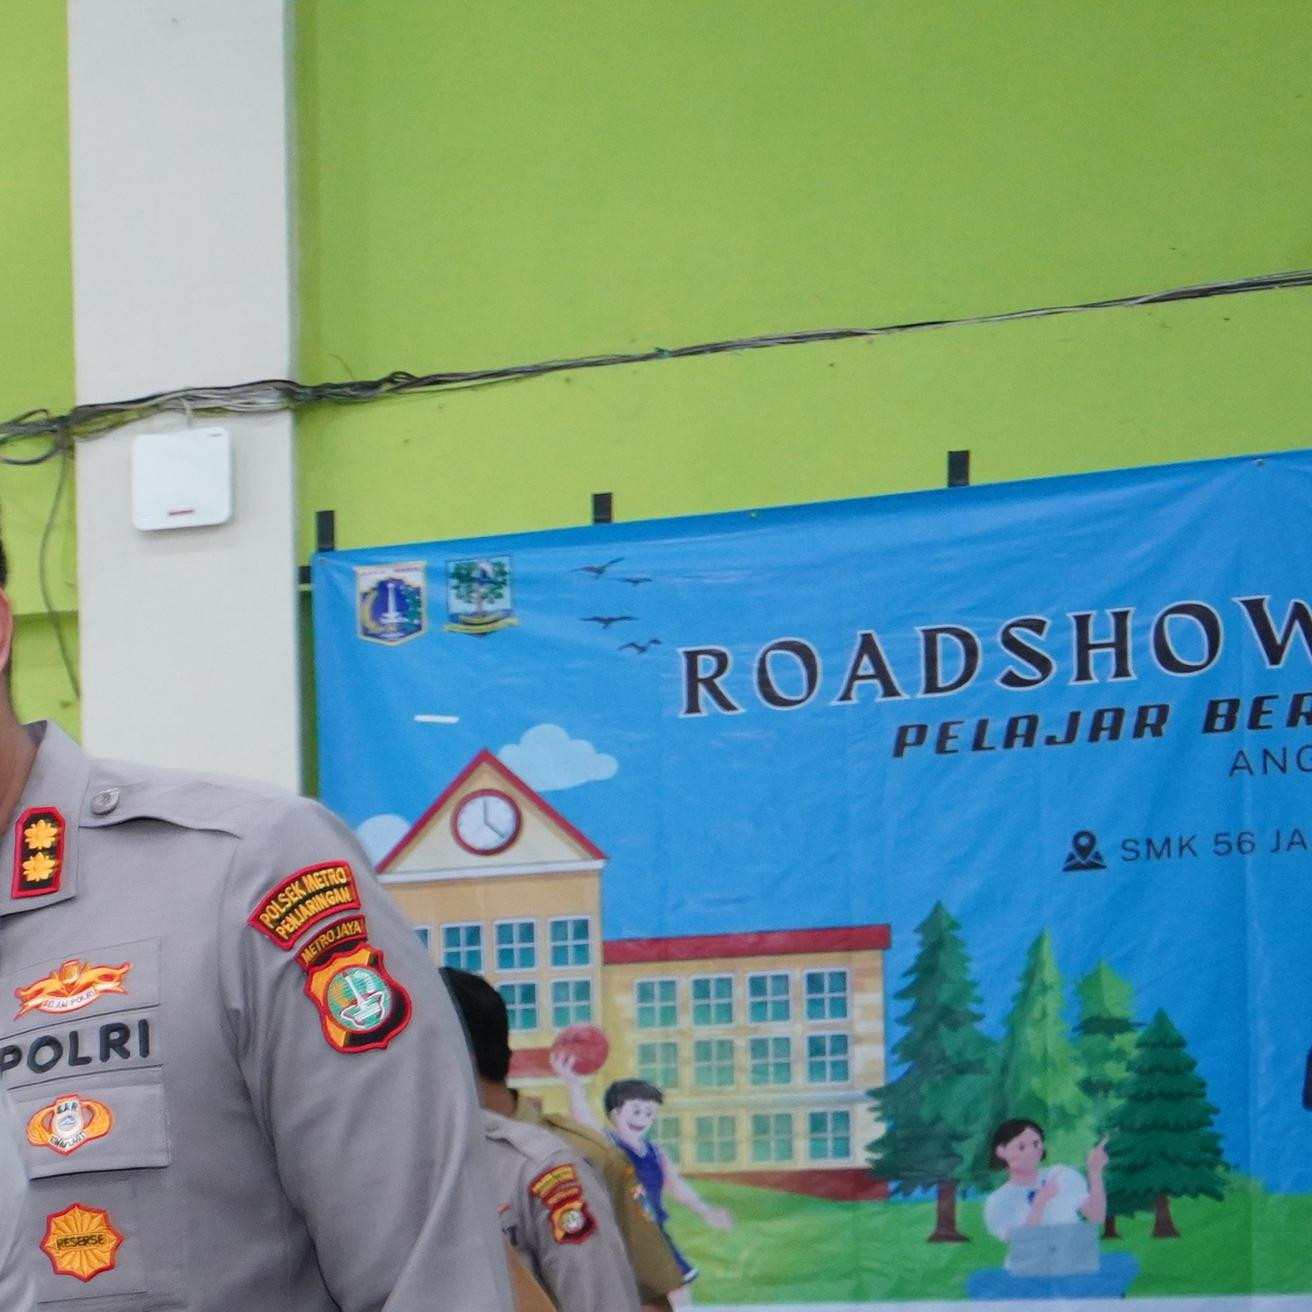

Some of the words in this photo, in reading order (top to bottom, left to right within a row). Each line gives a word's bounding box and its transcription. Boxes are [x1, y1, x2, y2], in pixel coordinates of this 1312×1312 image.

[678, 595, 1312, 717] ROADSHOW
[892, 703, 1170, 758] PELAJAR
[1202, 691, 1312, 734] BER
[1120, 834, 1199, 863] SMK
[1212, 831, 1256, 857] 56
[1270, 828, 1308, 853] JA
[259, 881, 306, 929] POLSEK
[302, 867, 347, 893] METRO
[275, 886, 352, 940] PENJARINGAN
[301, 931, 336, 965] METRO
[336, 920, 362, 939] JAYA
[56, 1234, 106, 1250] RESERSE
